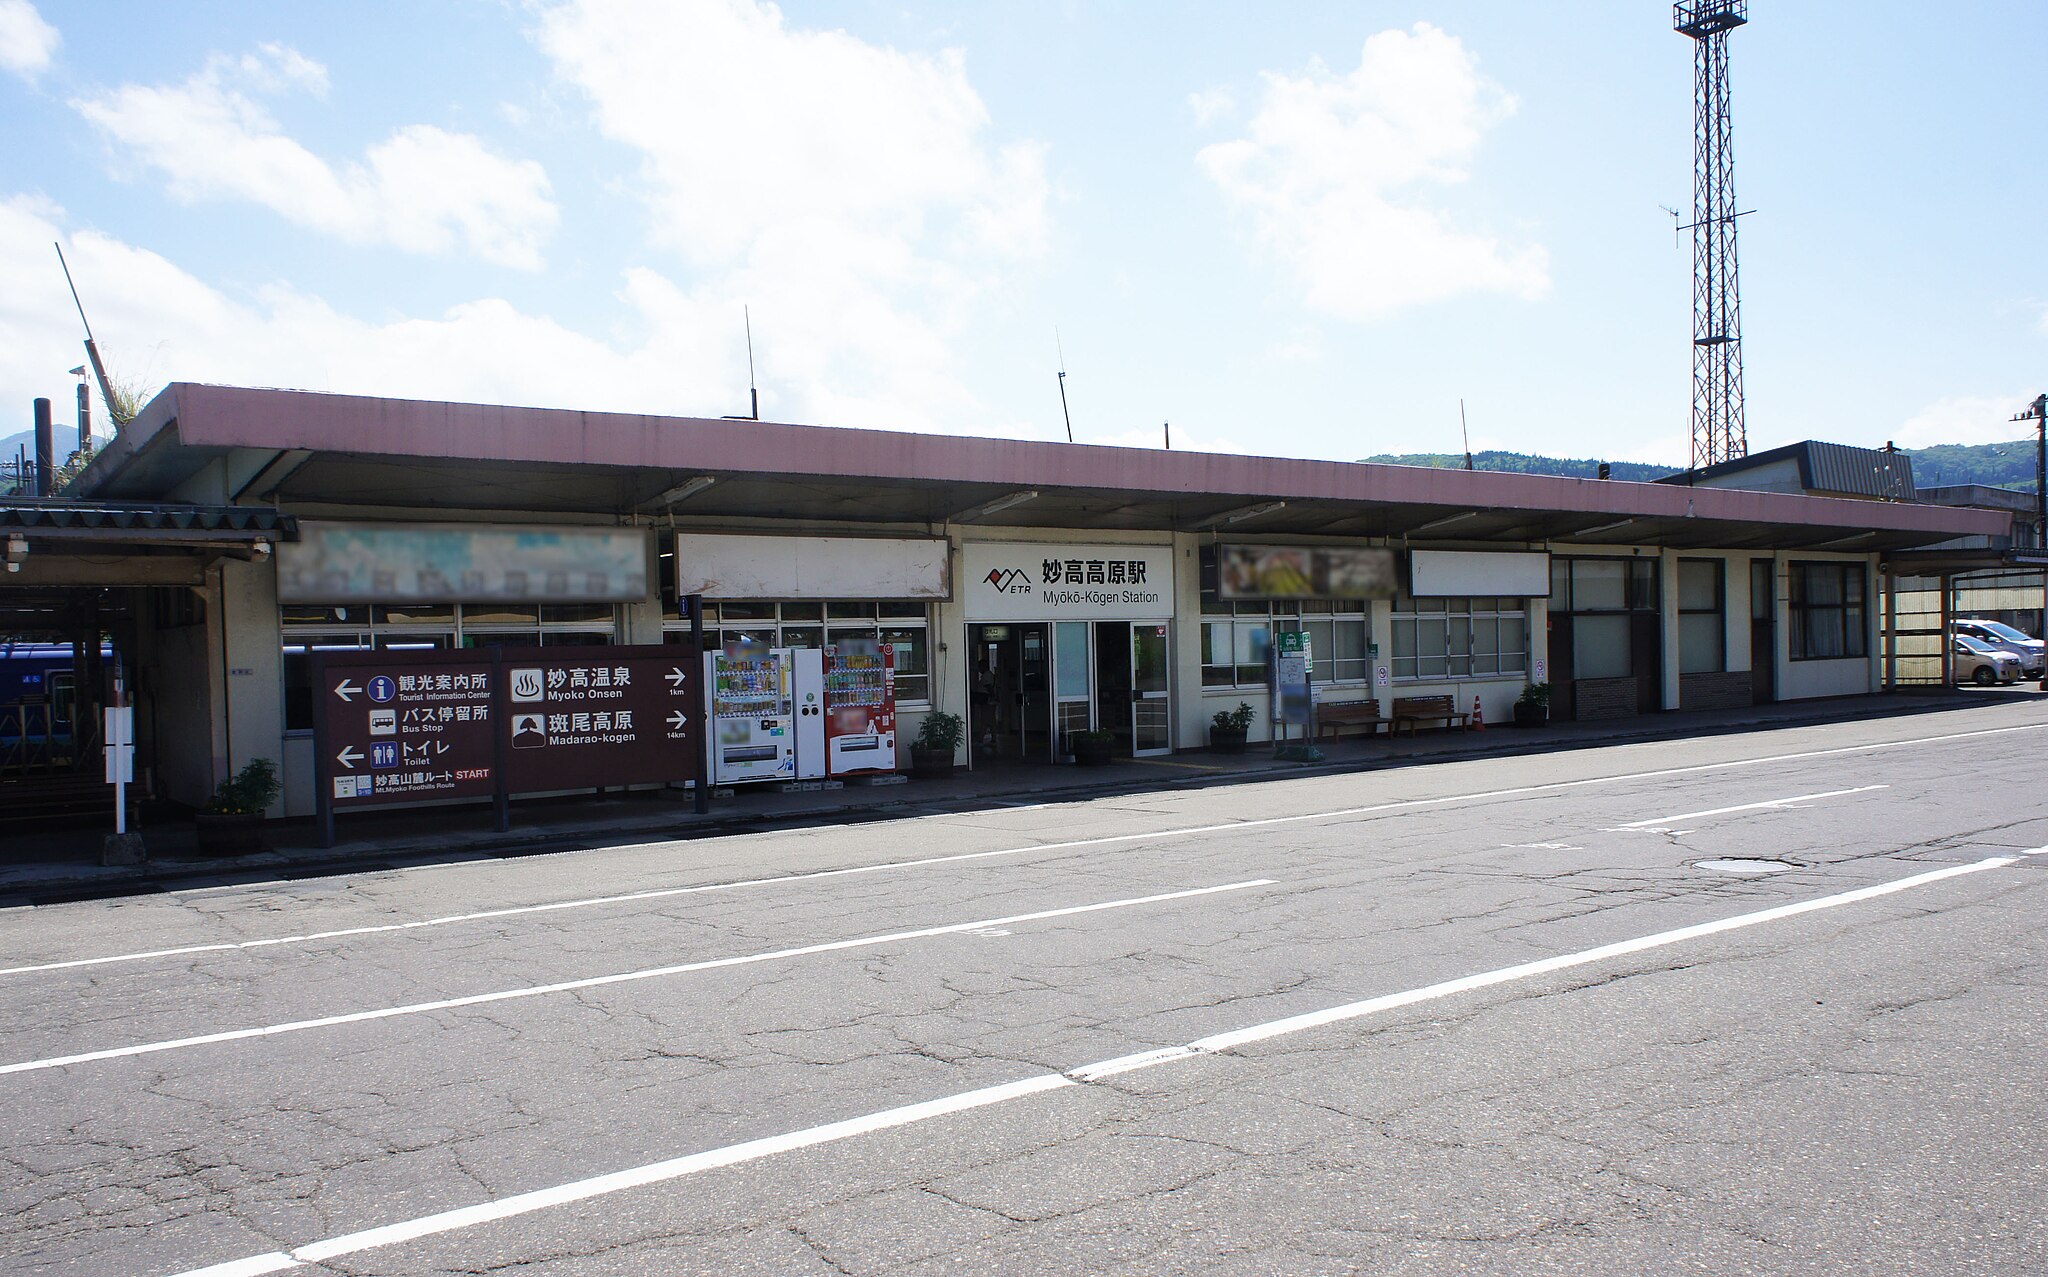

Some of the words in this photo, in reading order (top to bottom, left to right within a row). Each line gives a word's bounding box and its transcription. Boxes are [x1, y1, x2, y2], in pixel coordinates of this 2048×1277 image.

[1042, 559, 1147, 585] 妙高高原駅
[1010, 585, 1031, 594] ETR
[1043, 590, 1119, 606] Myōkō-Kōgen
[1122, 590, 1159, 603] Station
[399, 674, 487, 691] 観光案内所
[548, 667, 631, 688] 妙高温泉
[426, 692, 466, 700] Information
[548, 690, 585, 702] Myoko
[588, 689, 623, 699] Onsen
[403, 705, 488, 722] バス停留所
[549, 711, 633, 732] 斑尾高原
[402, 725, 420, 733] Bus
[422, 724, 444, 734] Stop
[549, 733, 635, 745] Madarao-kogen
[402, 740, 450, 757] トイレ
[375, 771, 453, 786] 妙高山麓ルート
[456, 769, 489, 779] START
[408, 783, 435, 791] Foothills
